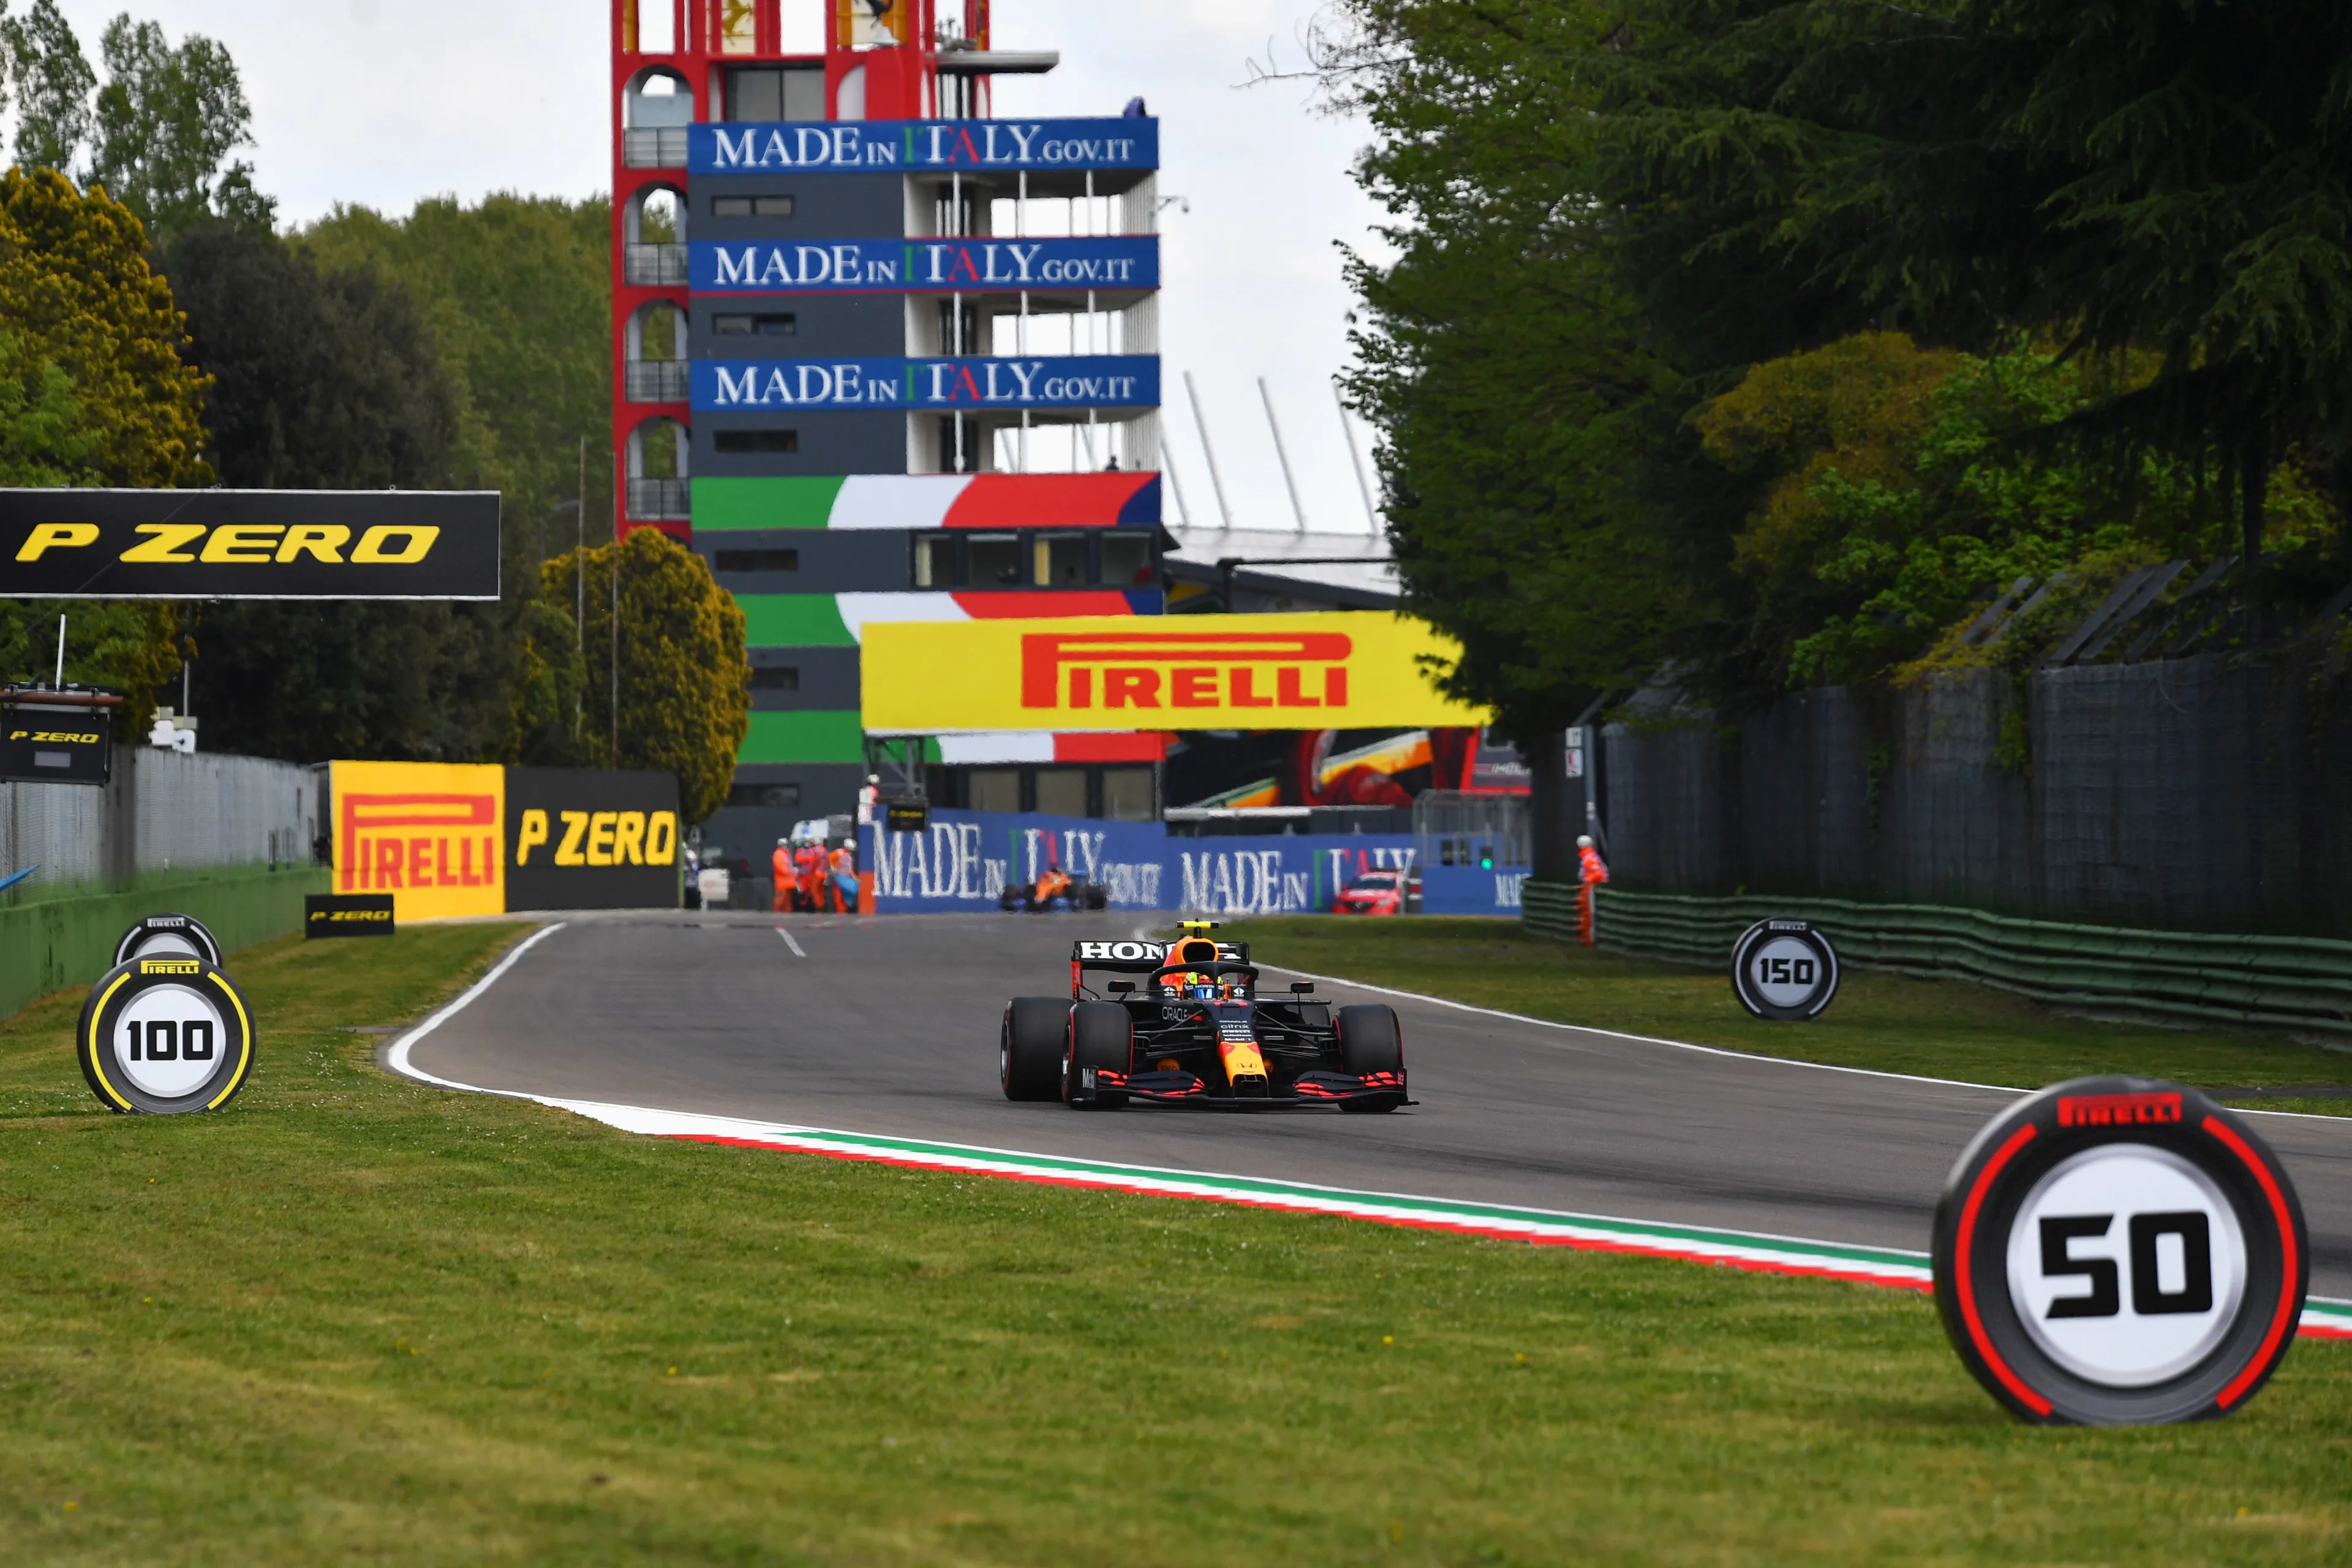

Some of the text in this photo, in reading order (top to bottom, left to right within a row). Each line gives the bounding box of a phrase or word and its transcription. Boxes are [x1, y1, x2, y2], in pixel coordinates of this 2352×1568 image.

[15, 522, 440, 564] P ZERO
[1021, 631, 1352, 709] PIRELLI
[9, 730, 100, 744] P ZERO
[341, 793, 495, 891] PIRELLI
[517, 809, 676, 866] P ZERO
[1180, 850, 1283, 915] MADE
[147, 917, 185, 927] PIRELLI
[310, 910, 391, 922] P ZERO
[141, 960, 200, 974] PIRELLI
[1080, 941, 1242, 960] HONA
[1760, 958, 1814, 984] 150
[1162, 1006, 1188, 1022] ORACLE
[126, 1020, 213, 1061] 100
[2057, 1091, 2183, 1128] PIRELLI
[2038, 1209, 2213, 1320] 50
